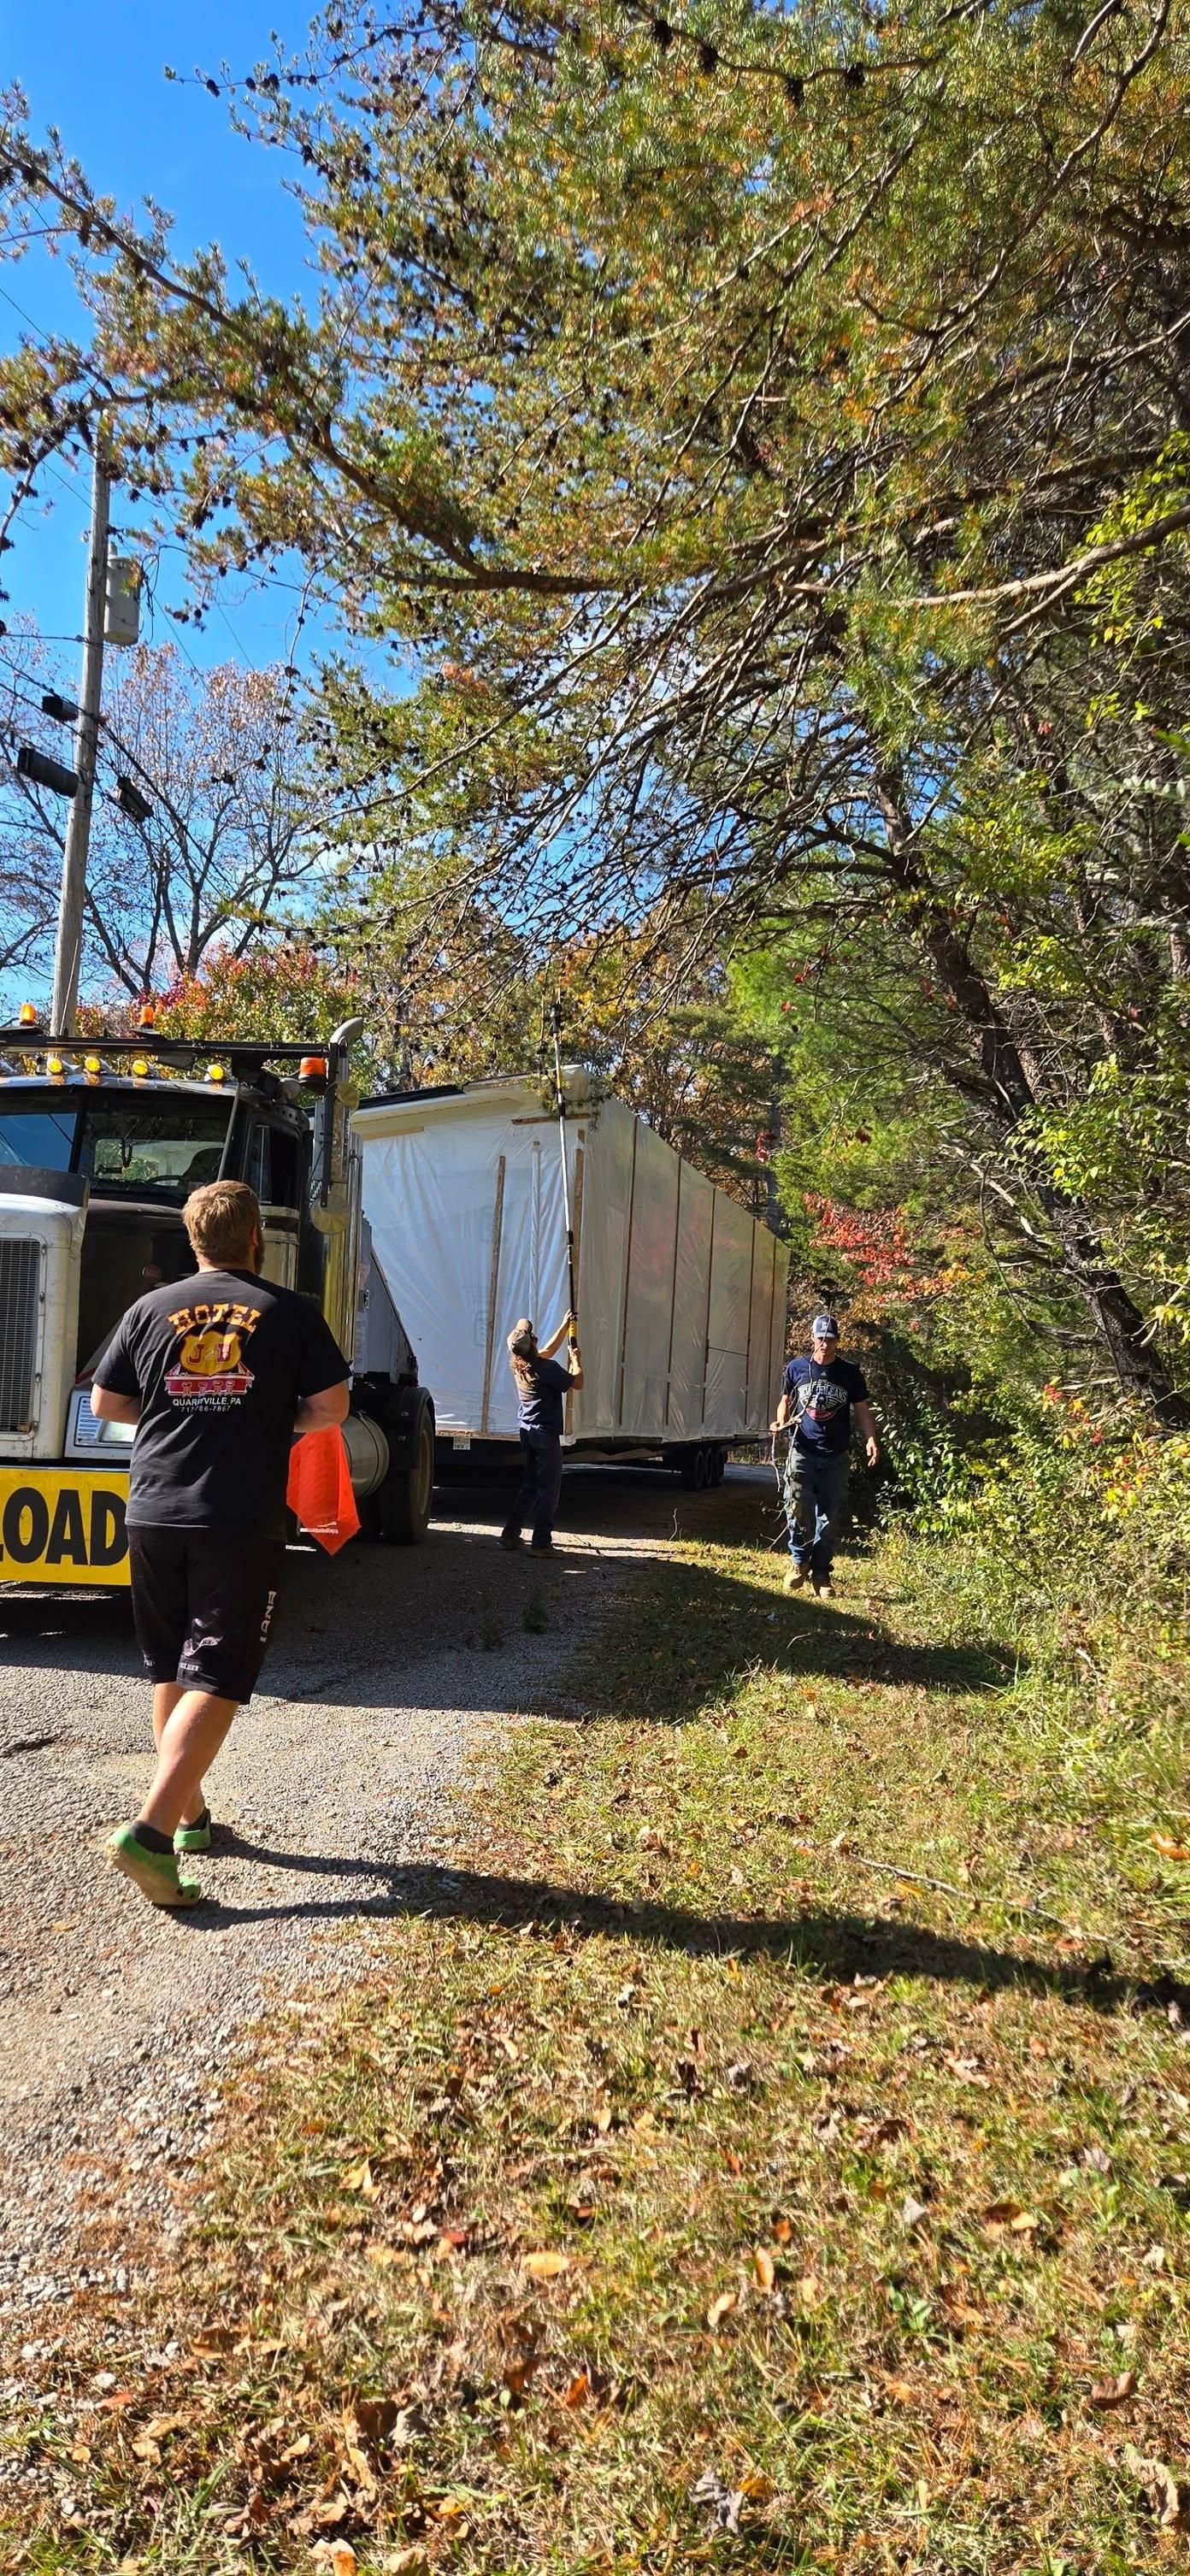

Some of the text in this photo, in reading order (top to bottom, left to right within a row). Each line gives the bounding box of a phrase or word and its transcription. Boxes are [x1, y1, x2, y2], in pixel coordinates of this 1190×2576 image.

[168, 1303, 262, 1335] HOTEL
[230, 1397, 241, 1406] PA
[816, 1384, 848, 1403] ORLEANS
[0, 1487, 130, 1566] OAD
